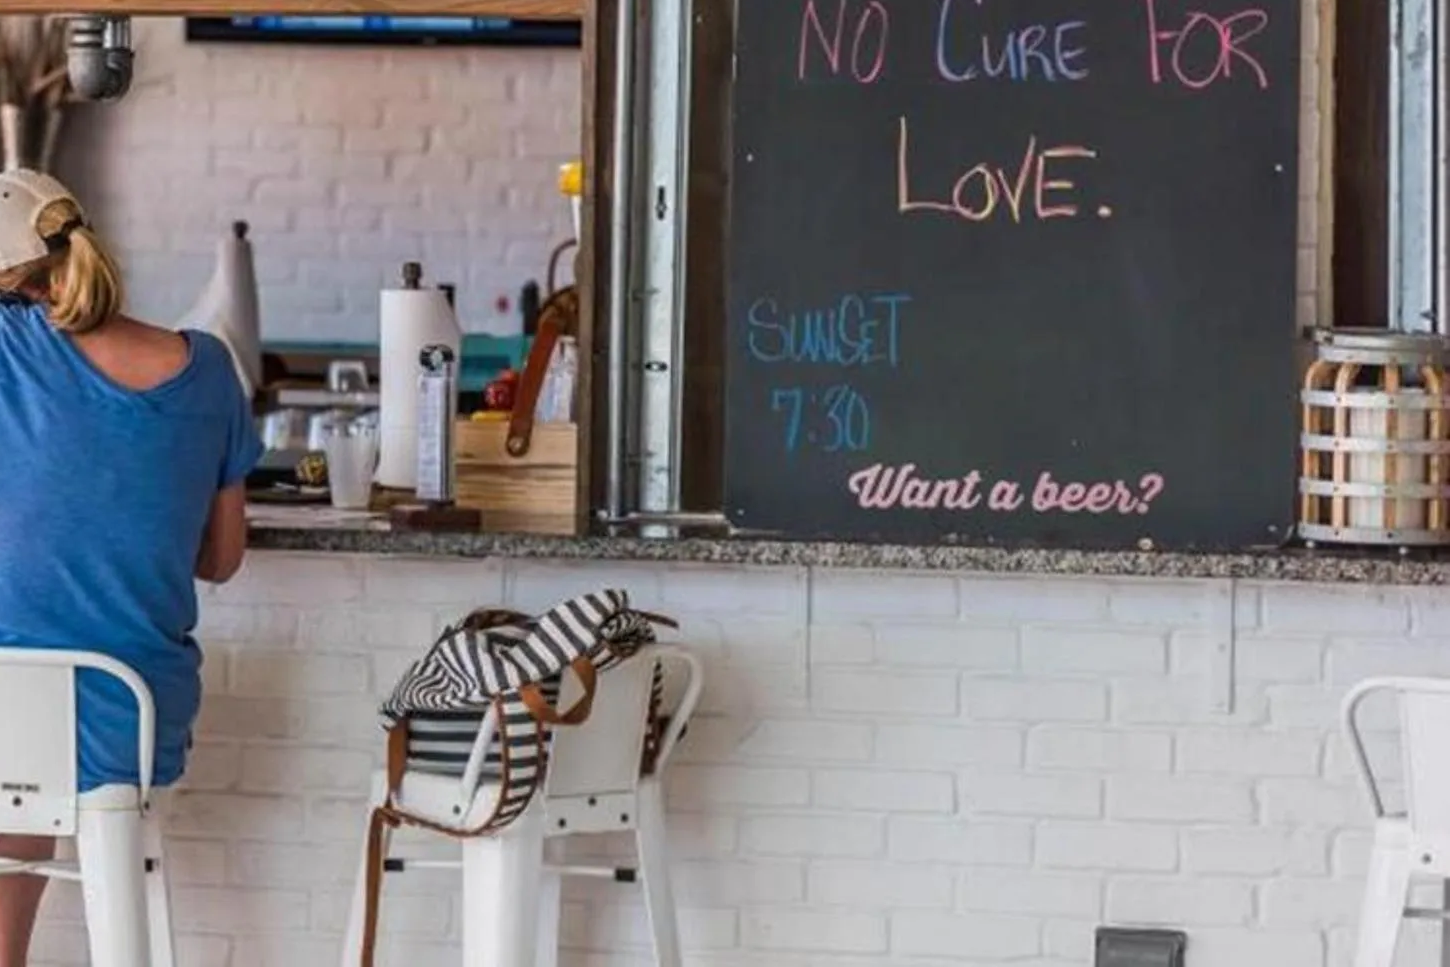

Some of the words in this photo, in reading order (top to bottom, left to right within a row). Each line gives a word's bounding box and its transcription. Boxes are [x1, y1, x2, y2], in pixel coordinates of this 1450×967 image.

[898, 116, 1113, 223] LOVE.
[748, 293, 913, 368] SUNSET
[770, 383, 870, 454] 7:30
[849, 462, 983, 510] Want
[988, 483, 1023, 511] a
[1031, 472, 1164, 515] beer?
